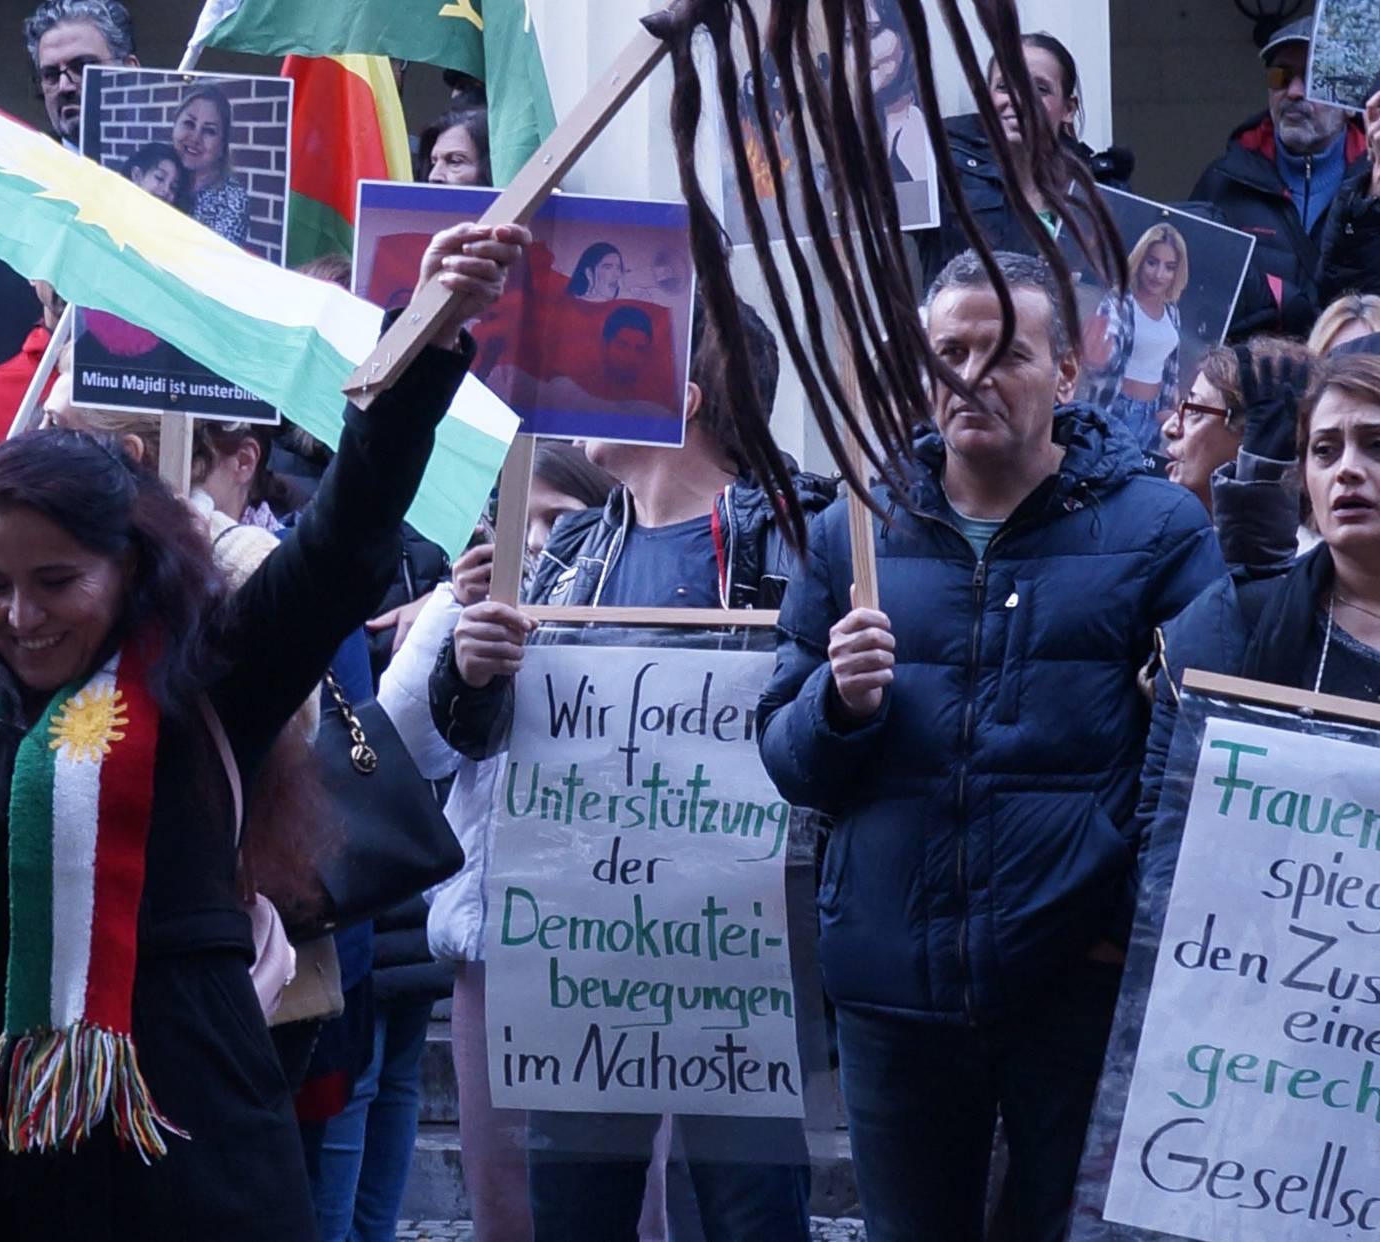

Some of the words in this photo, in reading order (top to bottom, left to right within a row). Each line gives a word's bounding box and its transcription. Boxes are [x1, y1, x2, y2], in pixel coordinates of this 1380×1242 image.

[82, 371, 119, 388] Minu
[122, 374, 166, 395] Majidi
[169, 379, 186, 394] ist
[545, 673, 615, 739] Wir
[506, 762, 791, 862] Unterstützung
[1210, 739, 1380, 851] Frauen
[592, 836, 673, 884] der
[500, 886, 783, 961] Demokratei-
[1173, 913, 1268, 984] den
[550, 957, 794, 1030] bewegungen
[503, 1025, 561, 1087] im
[573, 1023, 799, 1096] Nahosten
